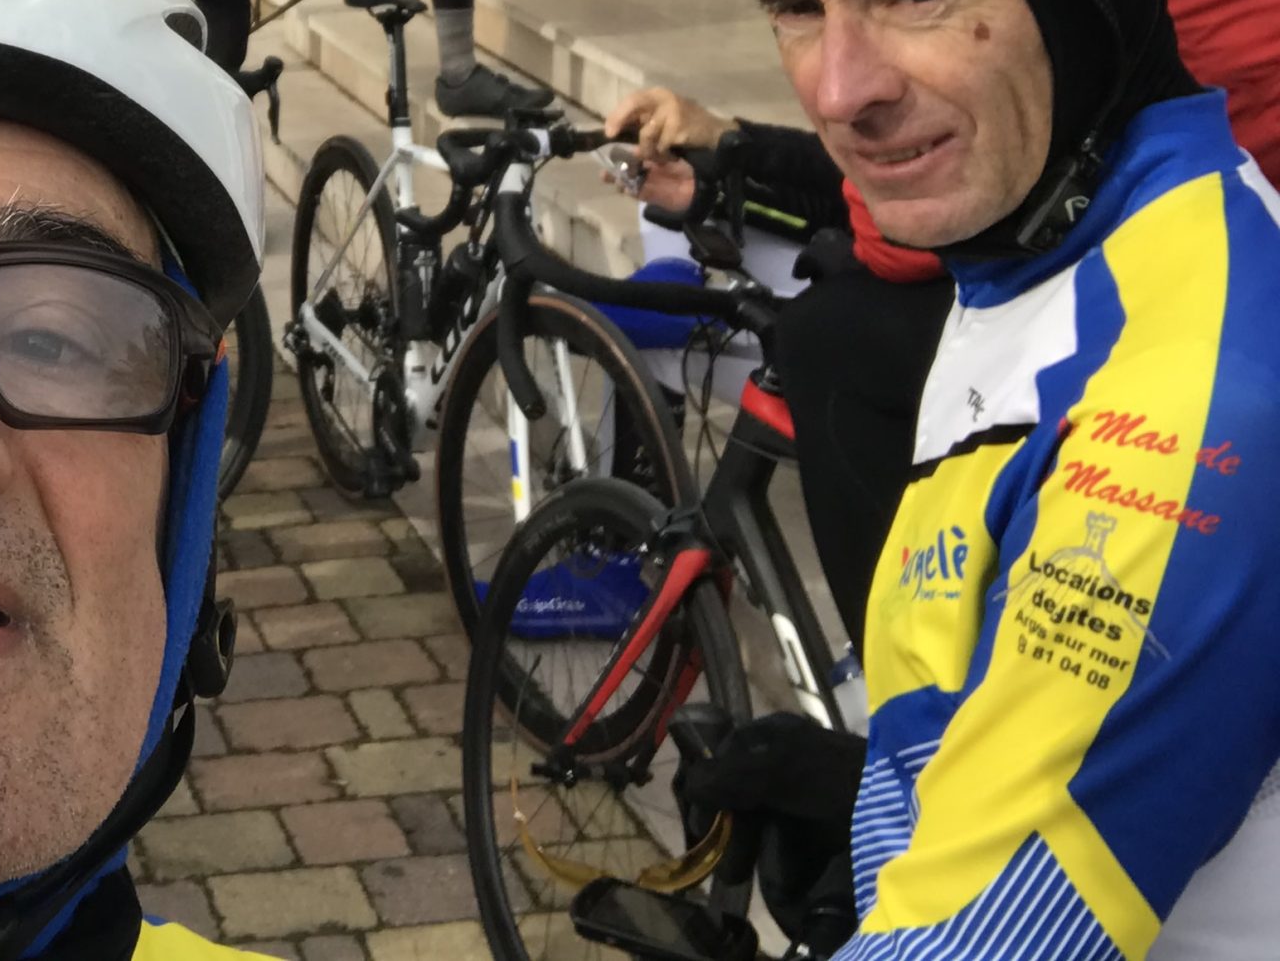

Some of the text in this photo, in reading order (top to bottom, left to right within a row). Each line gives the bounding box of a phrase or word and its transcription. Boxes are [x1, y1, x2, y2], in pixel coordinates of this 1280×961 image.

[1090, 410, 1242, 476] Mas de
[1063, 460, 1222, 535] Massane
[1059, 655, 1082, 677] 04
[1086, 669, 1111, 691] 08
[1089, 646, 1130, 672] mer
